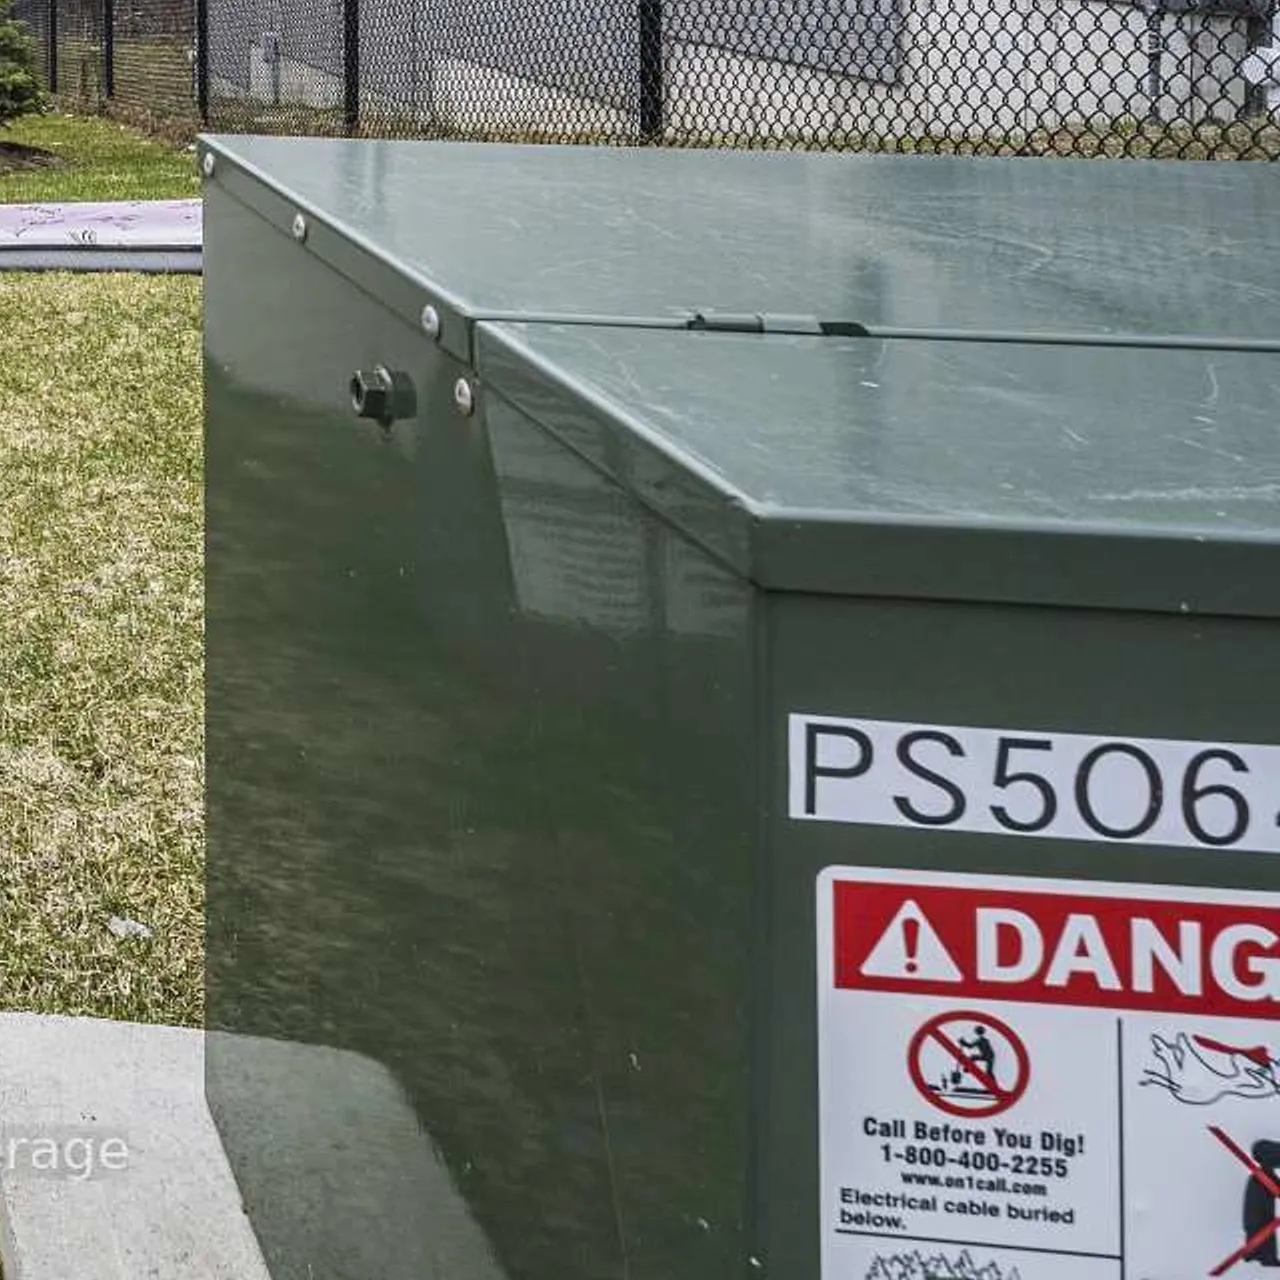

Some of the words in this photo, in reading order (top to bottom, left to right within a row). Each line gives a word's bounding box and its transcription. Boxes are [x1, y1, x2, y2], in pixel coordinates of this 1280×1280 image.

[805, 723, 1280, 847] PS506
[863, 1117, 905, 1138] Call
[915, 1121, 986, 1145] Before
[993, 1128, 1031, 1149] You
[1041, 1132, 1084, 1157] Dig!
[881, 1144, 1068, 1177] 1-800-400-2255
[901, 1172, 1047, 1196] www.on1call.com
[840, 1187, 937, 1211] Electrical
[944, 1199, 1000, 1217] cable
[1007, 1204, 1074, 1224] buried
[840, 1209, 906, 1229] below.
